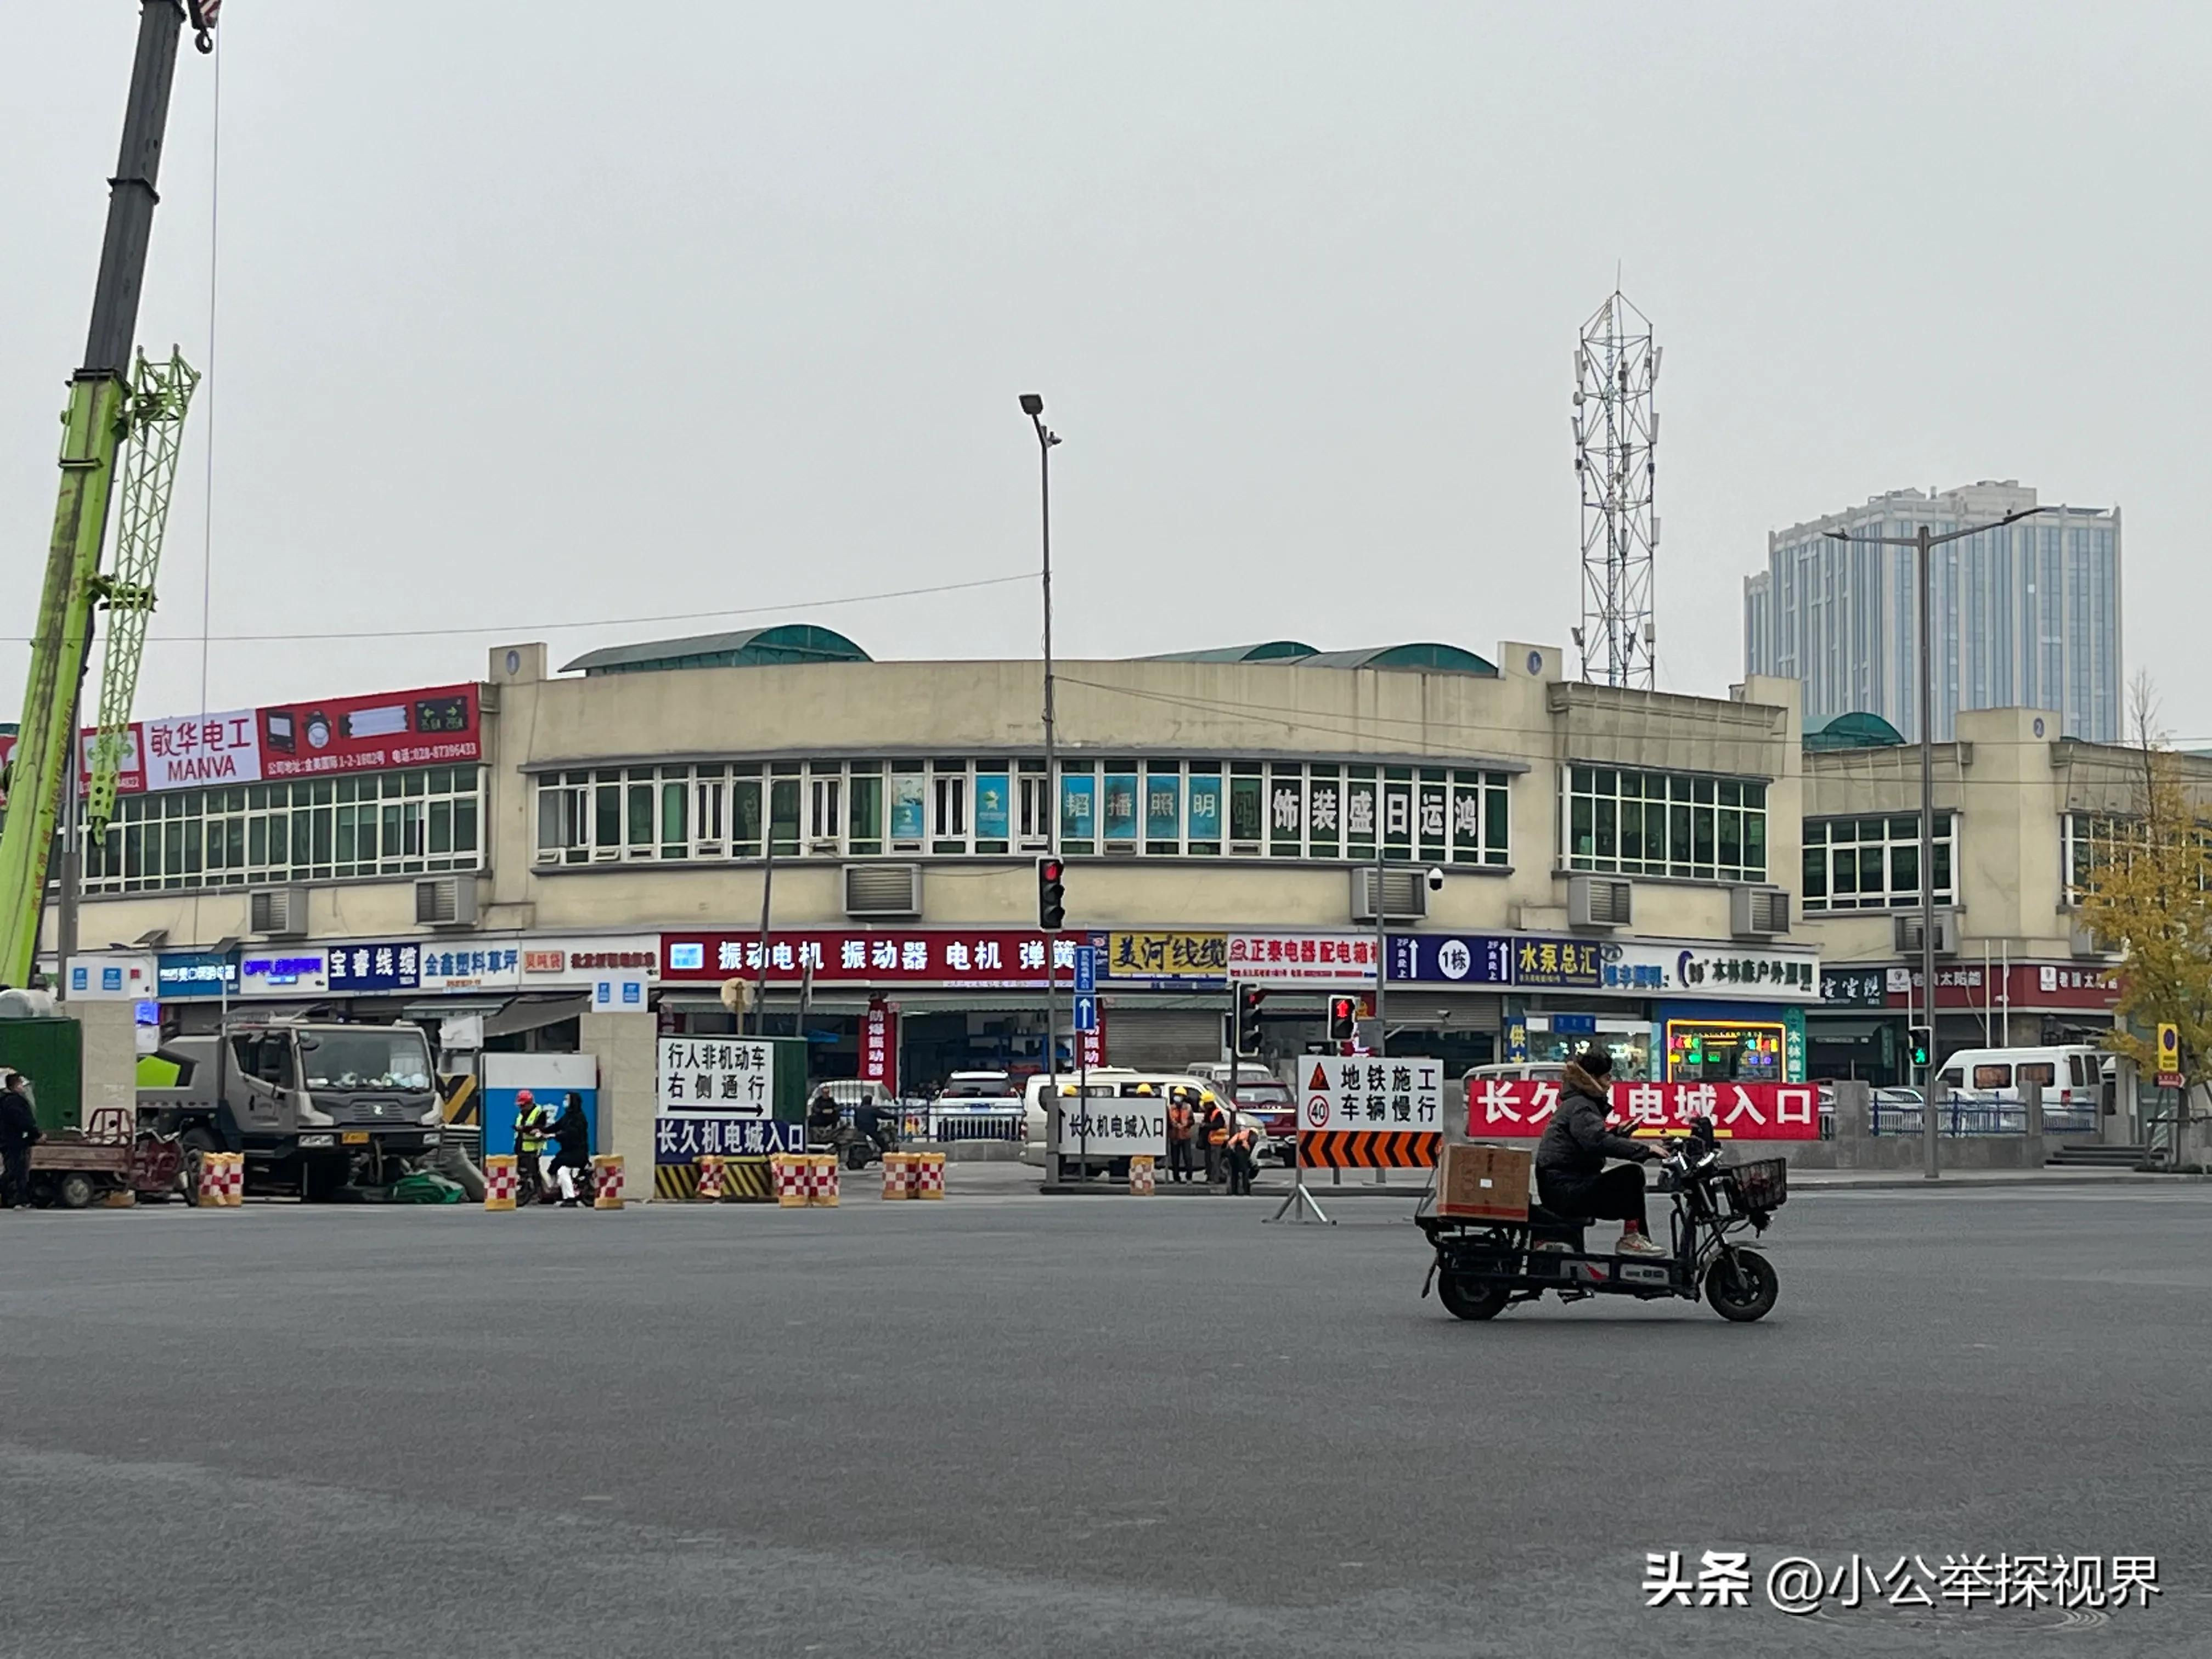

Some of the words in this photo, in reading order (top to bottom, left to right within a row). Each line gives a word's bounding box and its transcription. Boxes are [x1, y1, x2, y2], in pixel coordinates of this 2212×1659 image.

[151, 718, 251, 758] 敏华电工
[168, 755, 236, 781] MANVA
[718, 941, 824, 970] 振动电机
[841, 940, 928, 970] 振动器
[946, 940, 1002, 970] 电机
[1019, 940, 1077, 969] 弹簧
[1442, 949, 1467, 970] 1栋
[1519, 941, 1597, 974] 水泵总汇
[668, 1043, 765, 1071] 行人非机动车
[668, 1071, 765, 1100] 右侧通行
[1340, 1064, 1437, 1092] 地铁施工
[1311, 1103, 1325, 1120] 40
[1340, 1094, 1437, 1122] 车辆慢行
[657, 1120, 804, 1154] 长久机电城入口
[1069, 1114, 1164, 1138] 长久机电城入口
